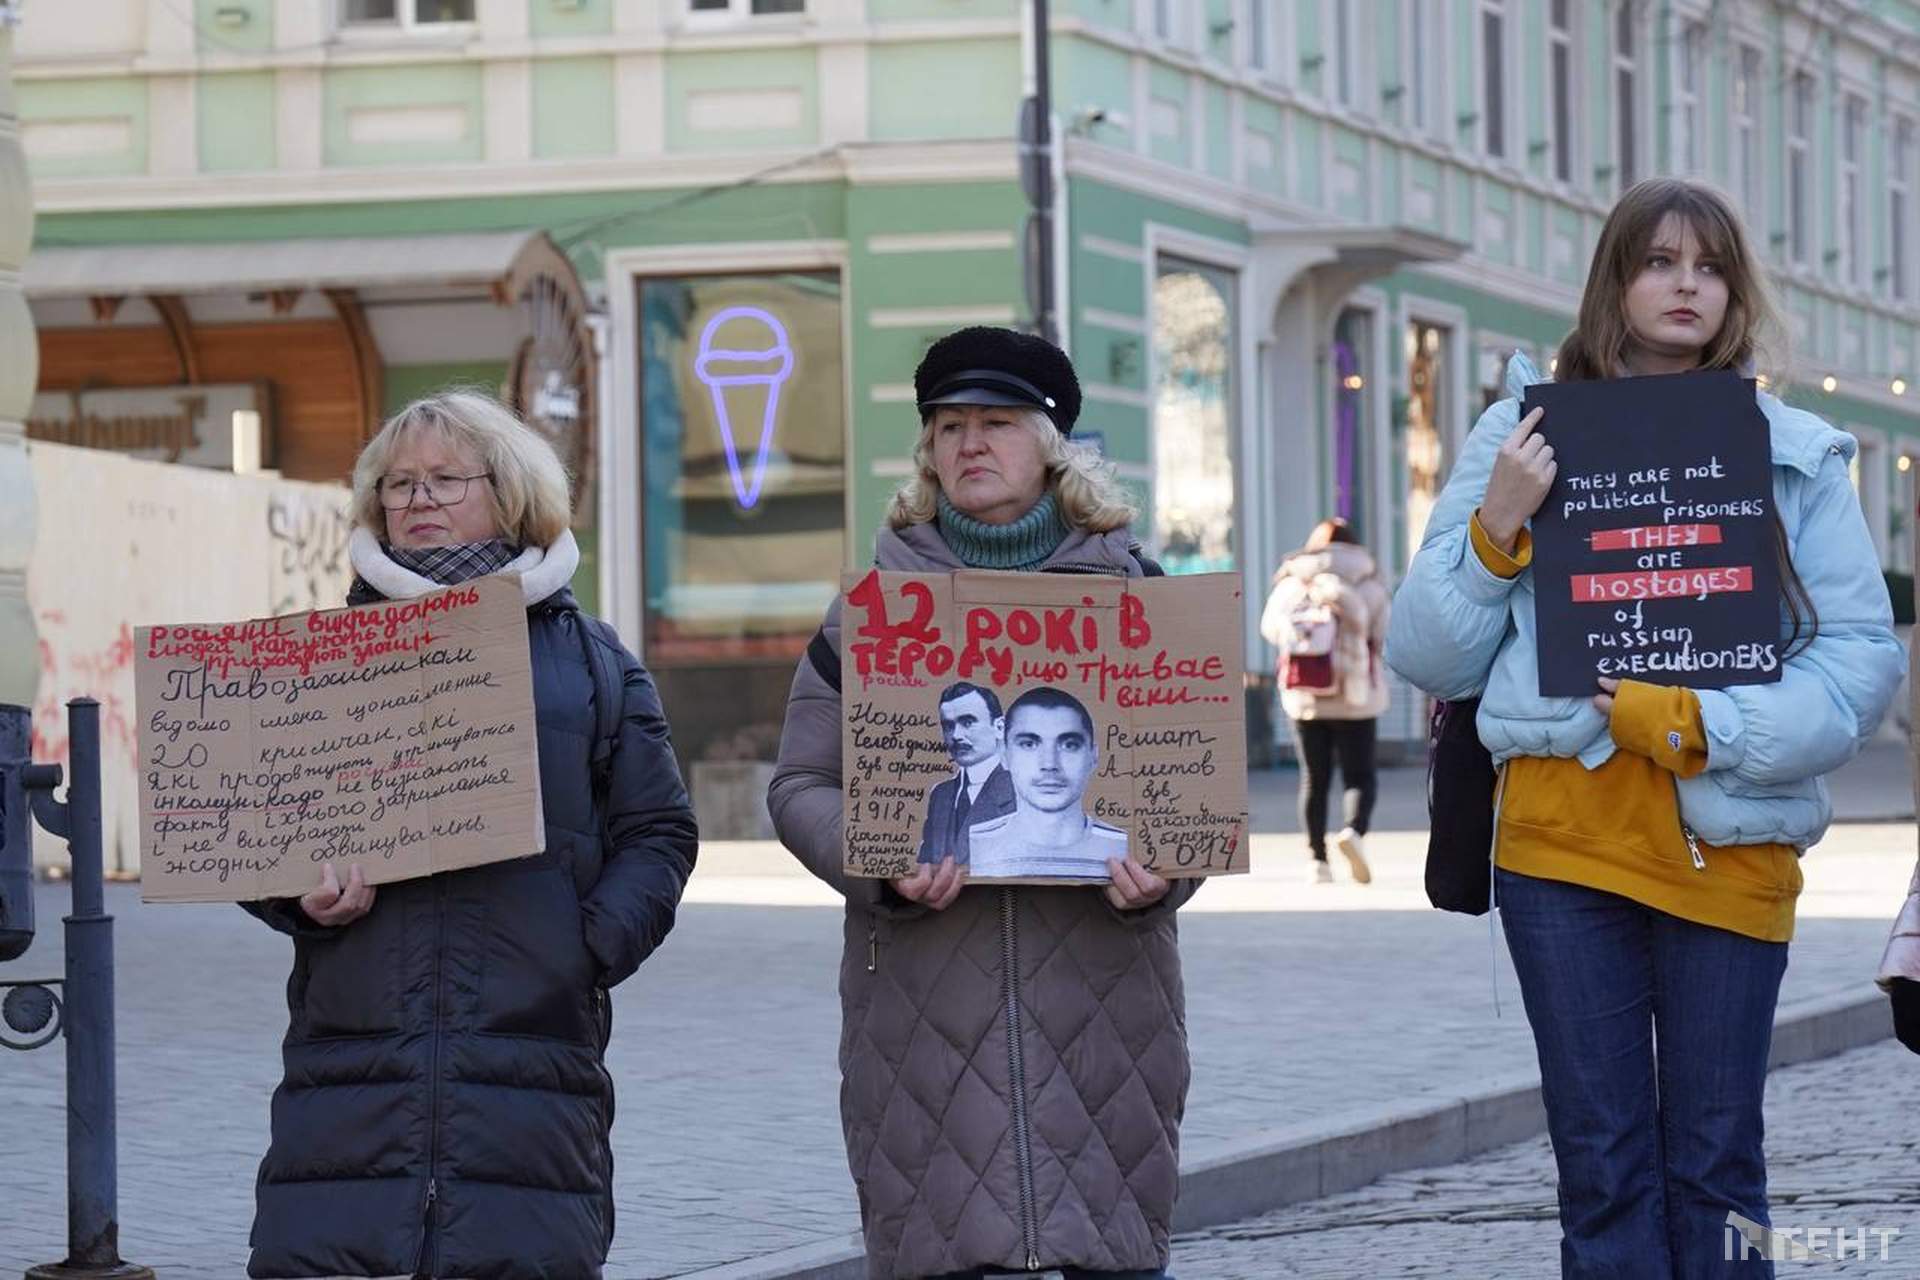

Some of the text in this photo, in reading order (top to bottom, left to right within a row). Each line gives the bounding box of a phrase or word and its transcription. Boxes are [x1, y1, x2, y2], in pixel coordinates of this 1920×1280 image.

[1567, 472, 1617, 491] THEY
[1685, 456, 1727, 480] not
[1622, 523, 1700, 549] THEY
[847, 569, 940, 643] 12
[1614, 600, 1644, 629] of
[1588, 626, 1693, 648] russian
[1077, 650, 1225, 702] триває
[151, 710, 231, 740] відомо
[848, 702, 937, 731] Номан
[1106, 724, 1217, 751] Решат
[151, 743, 209, 768] 20
[856, 755, 882, 780] був
[1098, 750, 1215, 778] Аметов
[336, 780, 364, 795] не
[849, 776, 925, 801] в лютому
[1142, 779, 1171, 805] був
[850, 801, 905, 822] 1918
[1095, 795, 1180, 817] вбитий
[153, 811, 230, 842] факту
[183, 839, 215, 854] не
[237, 823, 365, 855] висувають
[1142, 838, 1238, 872] 2014
[164, 857, 280, 883] жодних
